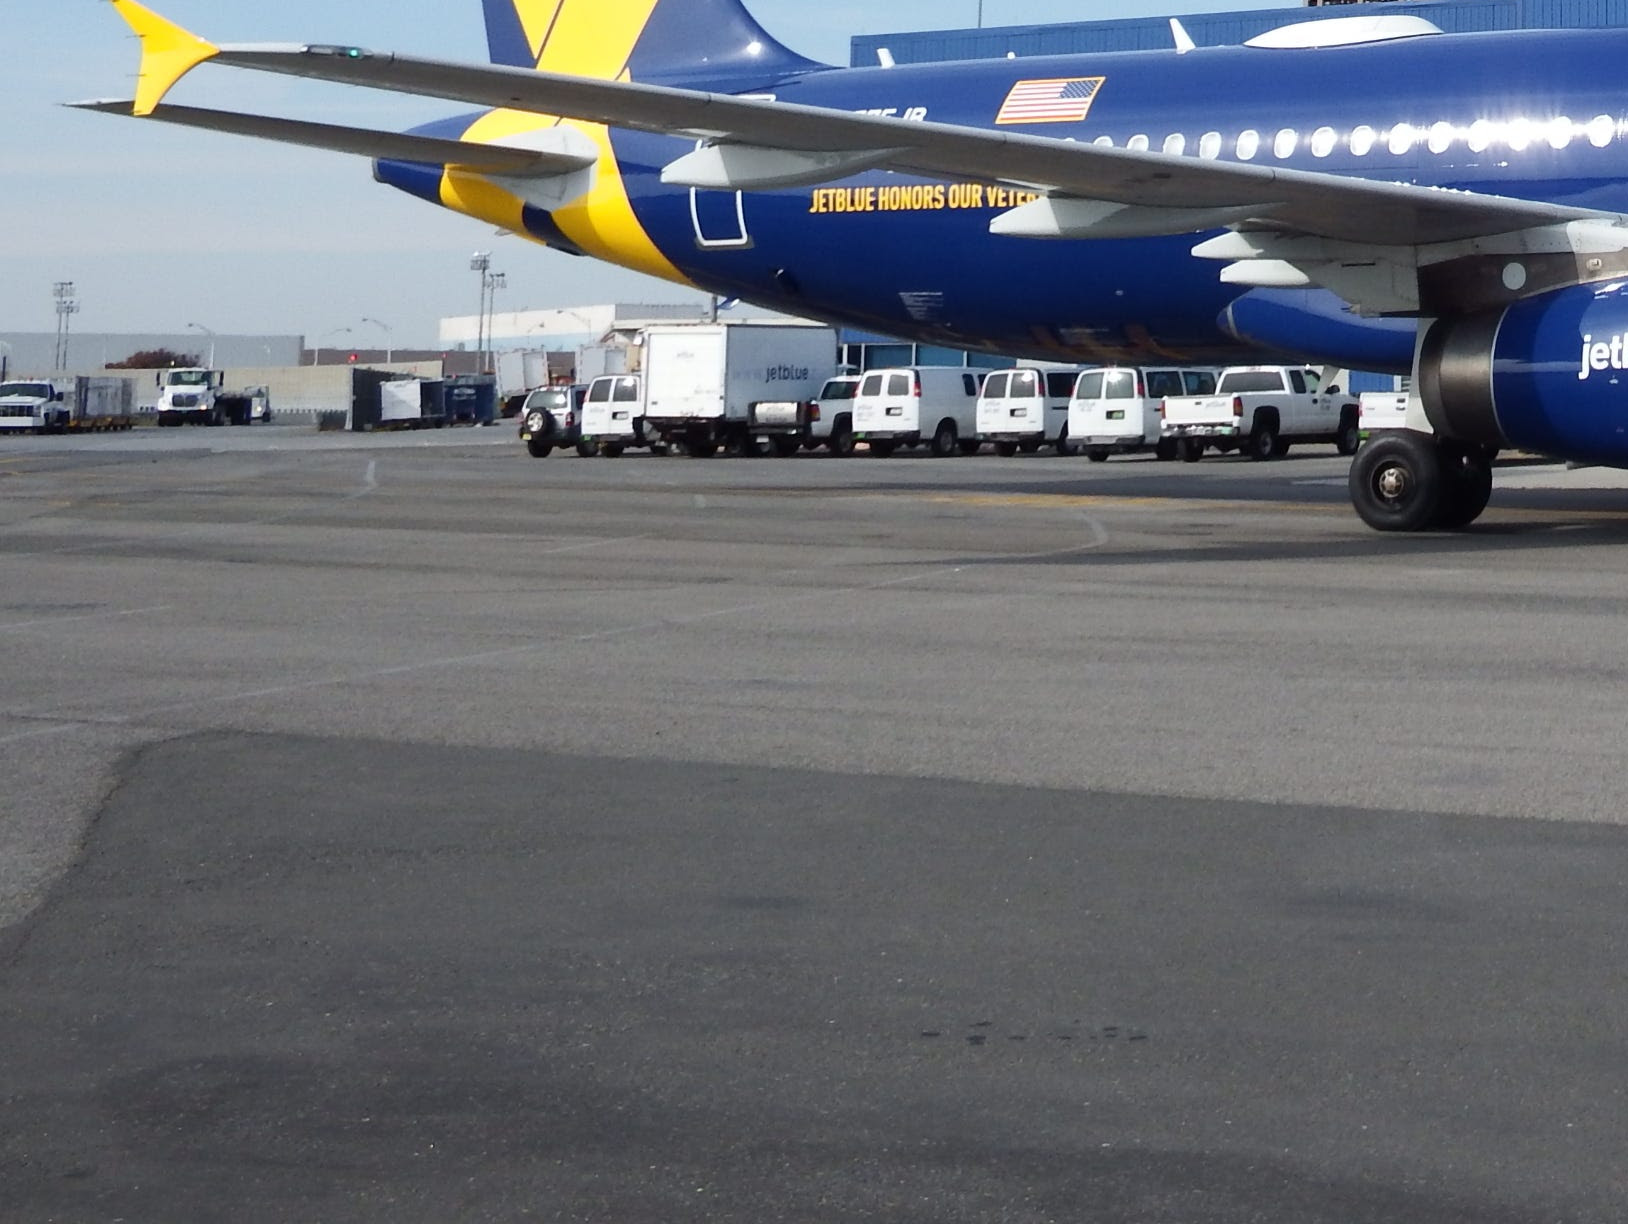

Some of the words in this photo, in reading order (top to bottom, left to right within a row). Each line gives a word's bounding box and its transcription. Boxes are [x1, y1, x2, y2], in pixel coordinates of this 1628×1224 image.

[809, 187, 876, 213] JETBLUE
[878, 185, 945, 211] HONORS
[948, 183, 983, 209] OUR
[765, 364, 809, 383] jetblue
